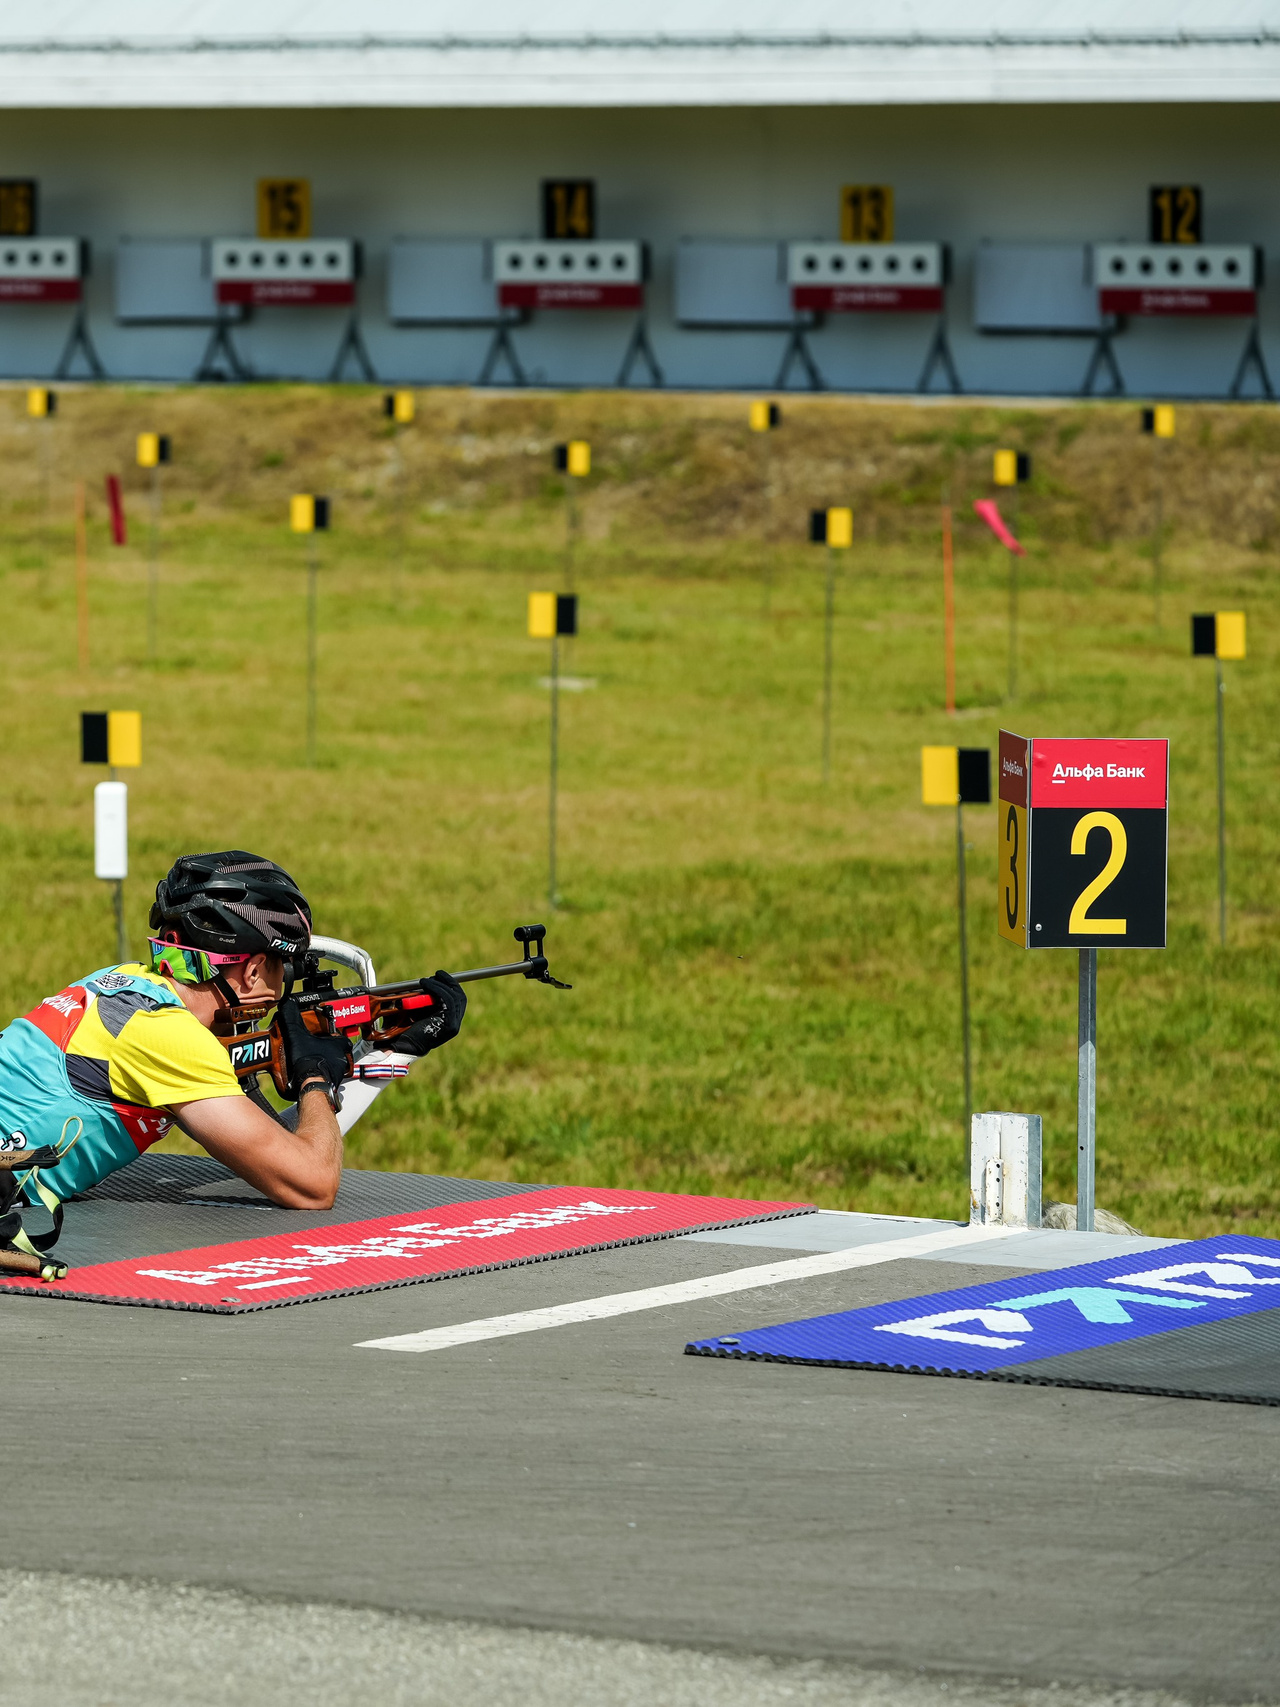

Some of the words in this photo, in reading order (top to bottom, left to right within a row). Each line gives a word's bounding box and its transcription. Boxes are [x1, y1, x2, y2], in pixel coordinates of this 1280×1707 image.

[266, 183, 302, 233] 15
[550, 183, 591, 237] 14
[848, 188, 886, 241] 13
[1155, 187, 1198, 243] 12
[1052, 763, 1104, 783] Альфа
[1107, 763, 1146, 778] Банк
[1005, 804, 1019, 930] 3
[1068, 811, 1128, 935] 2
[271, 938, 298, 953] PARI
[350, 1004, 366, 1015] Банк
[231, 1038, 270, 1066] PARI
[135, 1236, 462, 1290] Альфа
[390, 1201, 656, 1239] Банк
